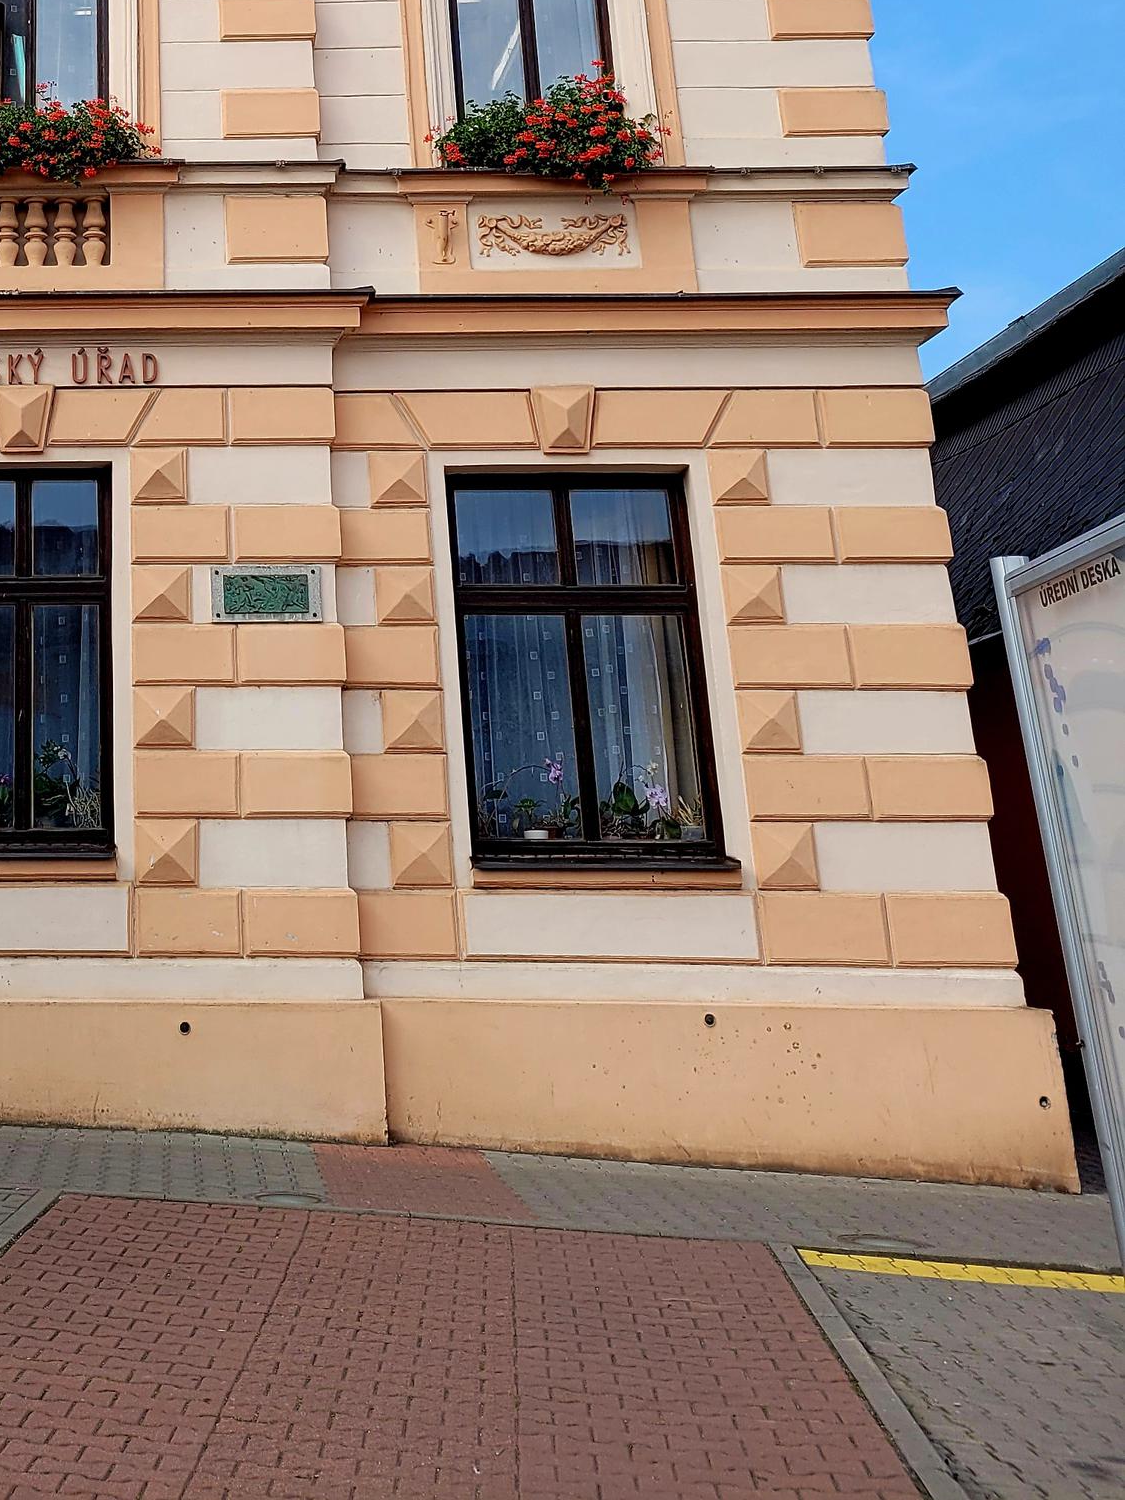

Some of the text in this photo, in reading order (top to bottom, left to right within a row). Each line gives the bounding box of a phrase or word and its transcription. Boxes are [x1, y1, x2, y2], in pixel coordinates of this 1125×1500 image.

[71, 346, 159, 385] ÚŘAD
[1039, 556, 1121, 608] ÚŘEDNÍ DESKA
